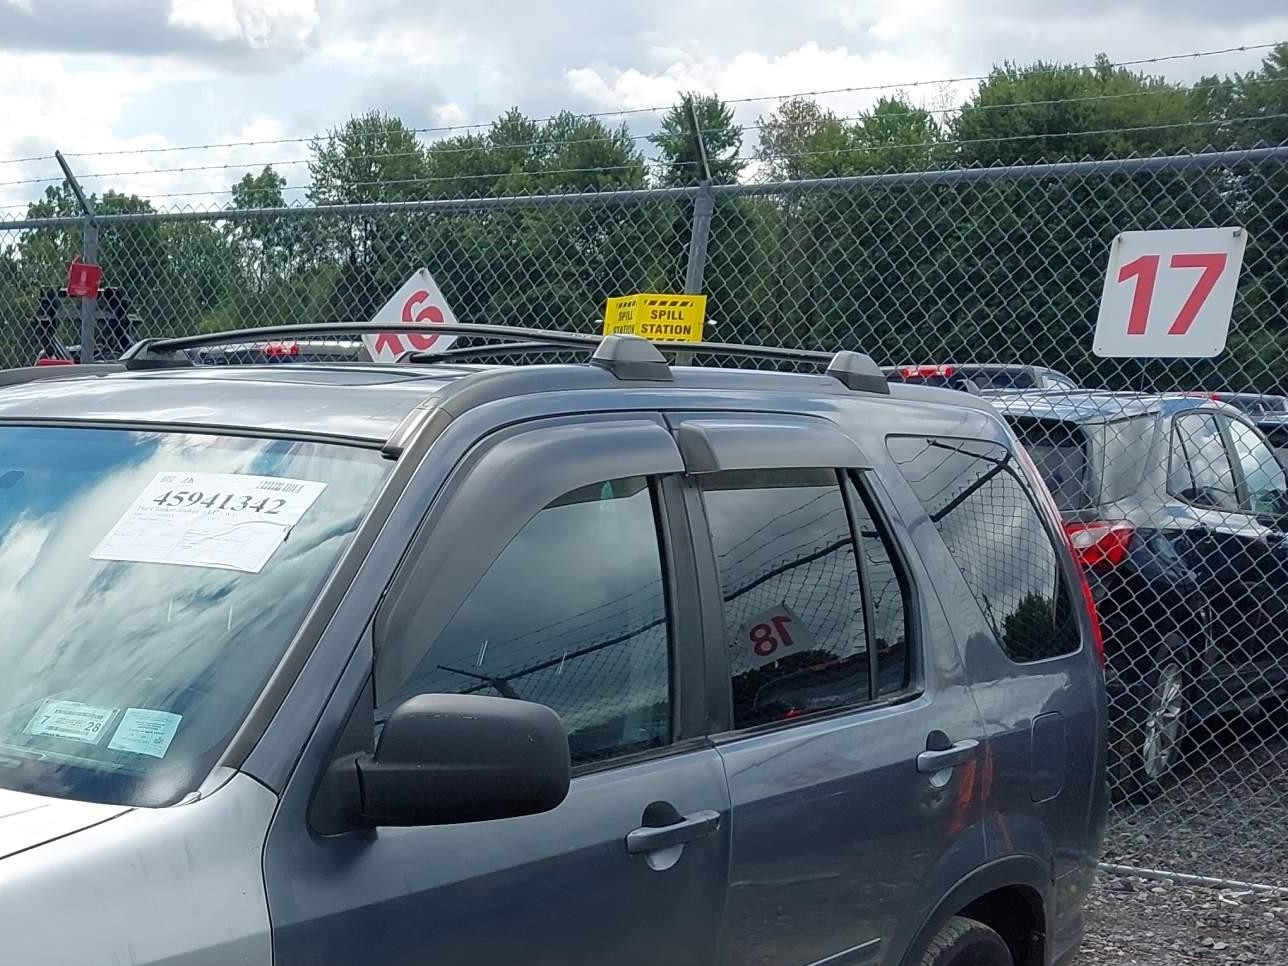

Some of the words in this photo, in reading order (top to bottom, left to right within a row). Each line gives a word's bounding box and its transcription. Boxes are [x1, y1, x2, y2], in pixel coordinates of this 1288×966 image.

[1117, 253, 1228, 335] 17
[650, 309, 685, 321] SPILL
[641, 323, 692, 335] STATION
[152, 489, 287, 515] 45941342
[84, 721, 102, 733] 28
